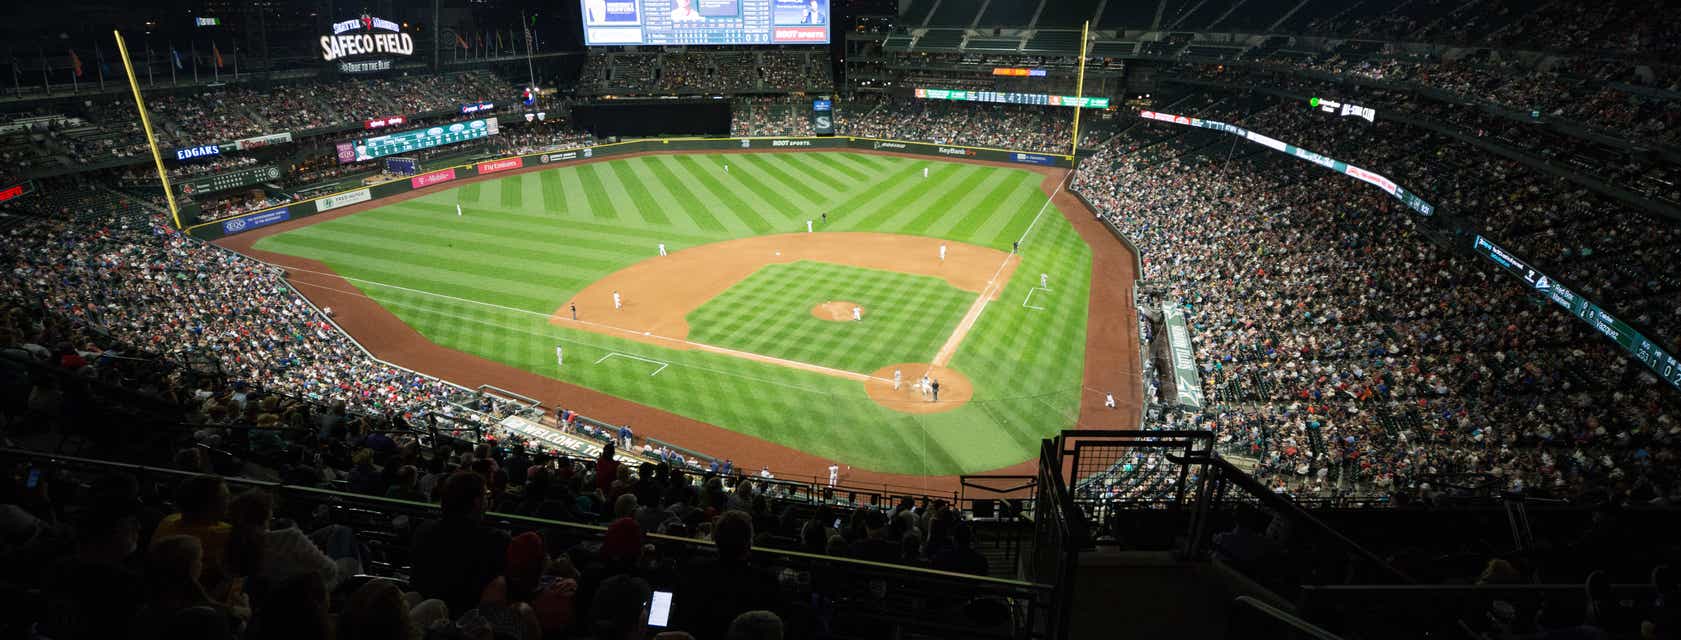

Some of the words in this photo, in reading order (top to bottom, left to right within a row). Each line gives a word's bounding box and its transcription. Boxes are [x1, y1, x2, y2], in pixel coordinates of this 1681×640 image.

[320, 34, 374, 61] SAFECO
[374, 33, 414, 56] FIELD
[177, 145, 219, 160] EDGARS
[939, 147, 966, 155] KeyBank
[1663, 365, 1672, 376] 0
[523, 424, 583, 450] WELCOME
